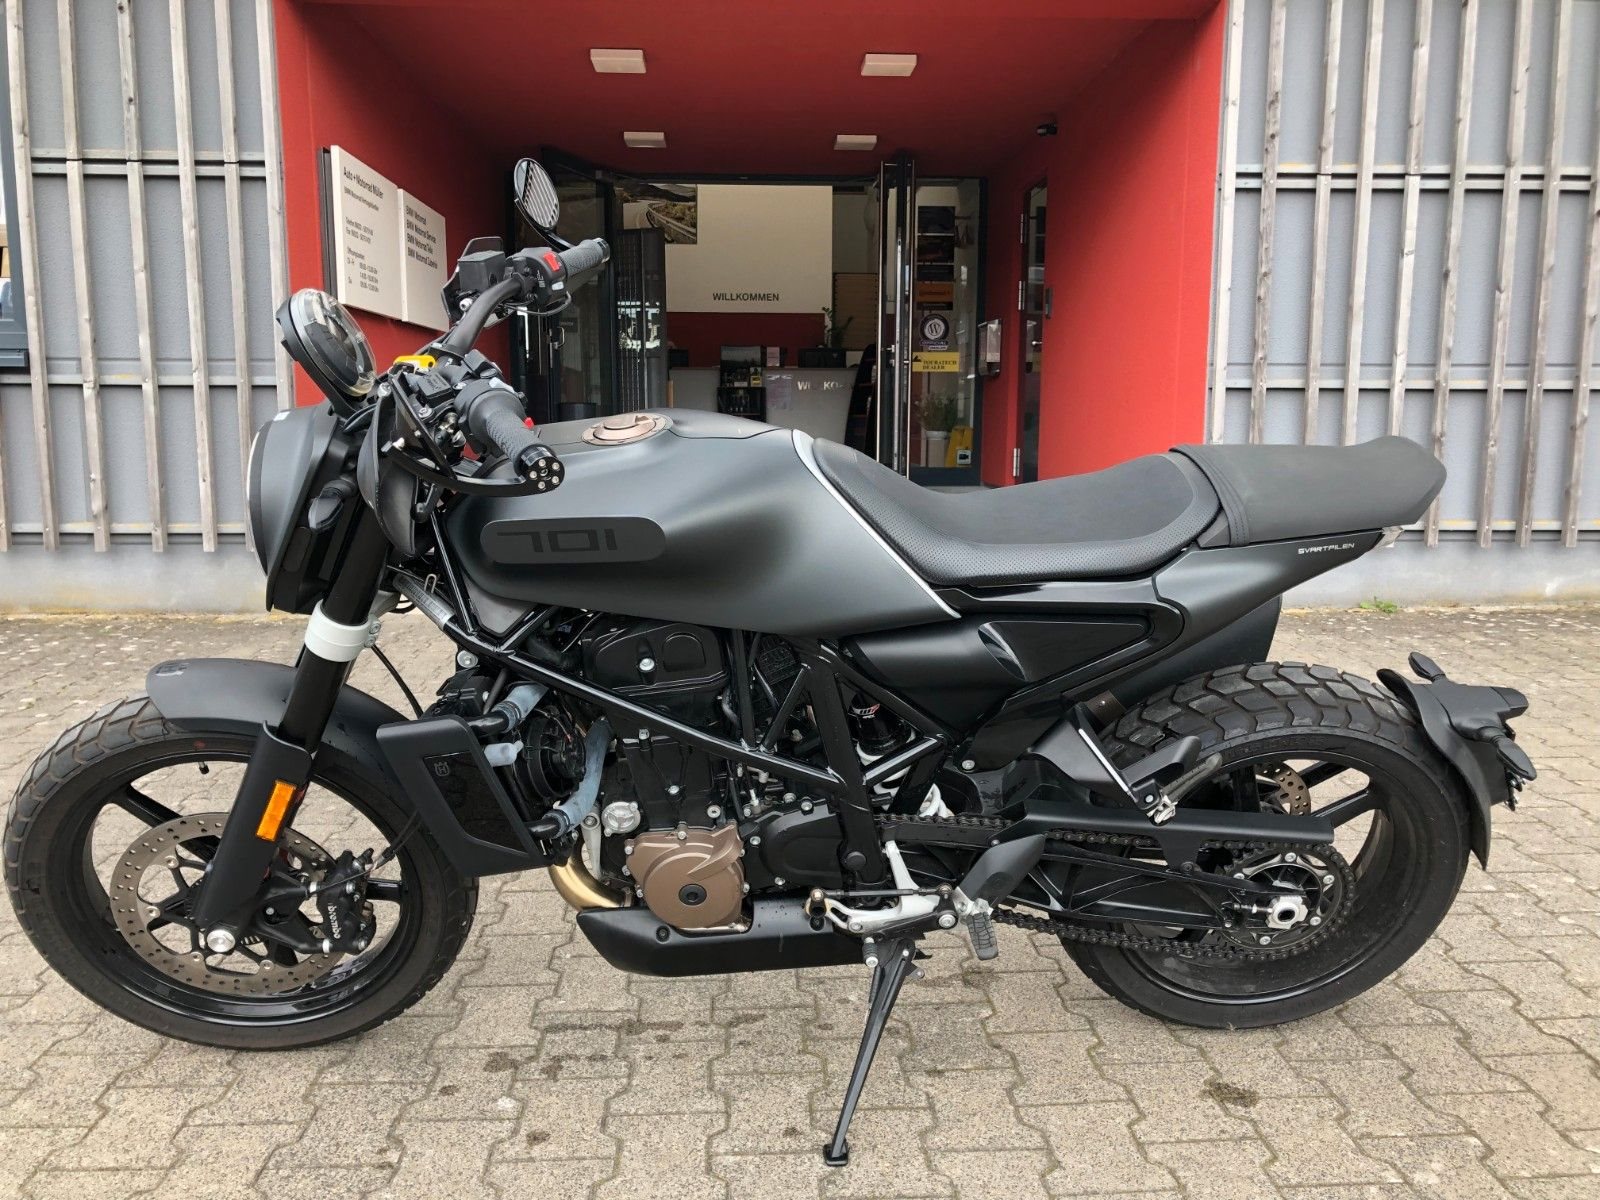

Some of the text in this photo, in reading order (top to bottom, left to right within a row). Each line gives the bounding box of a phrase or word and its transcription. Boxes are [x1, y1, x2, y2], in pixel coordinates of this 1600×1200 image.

[712, 293, 780, 302] WILLKOMMEN
[497, 528, 618, 553] 701
[1298, 543, 1355, 555] SVARTPILEN
[327, 905, 342, 939] brembo
